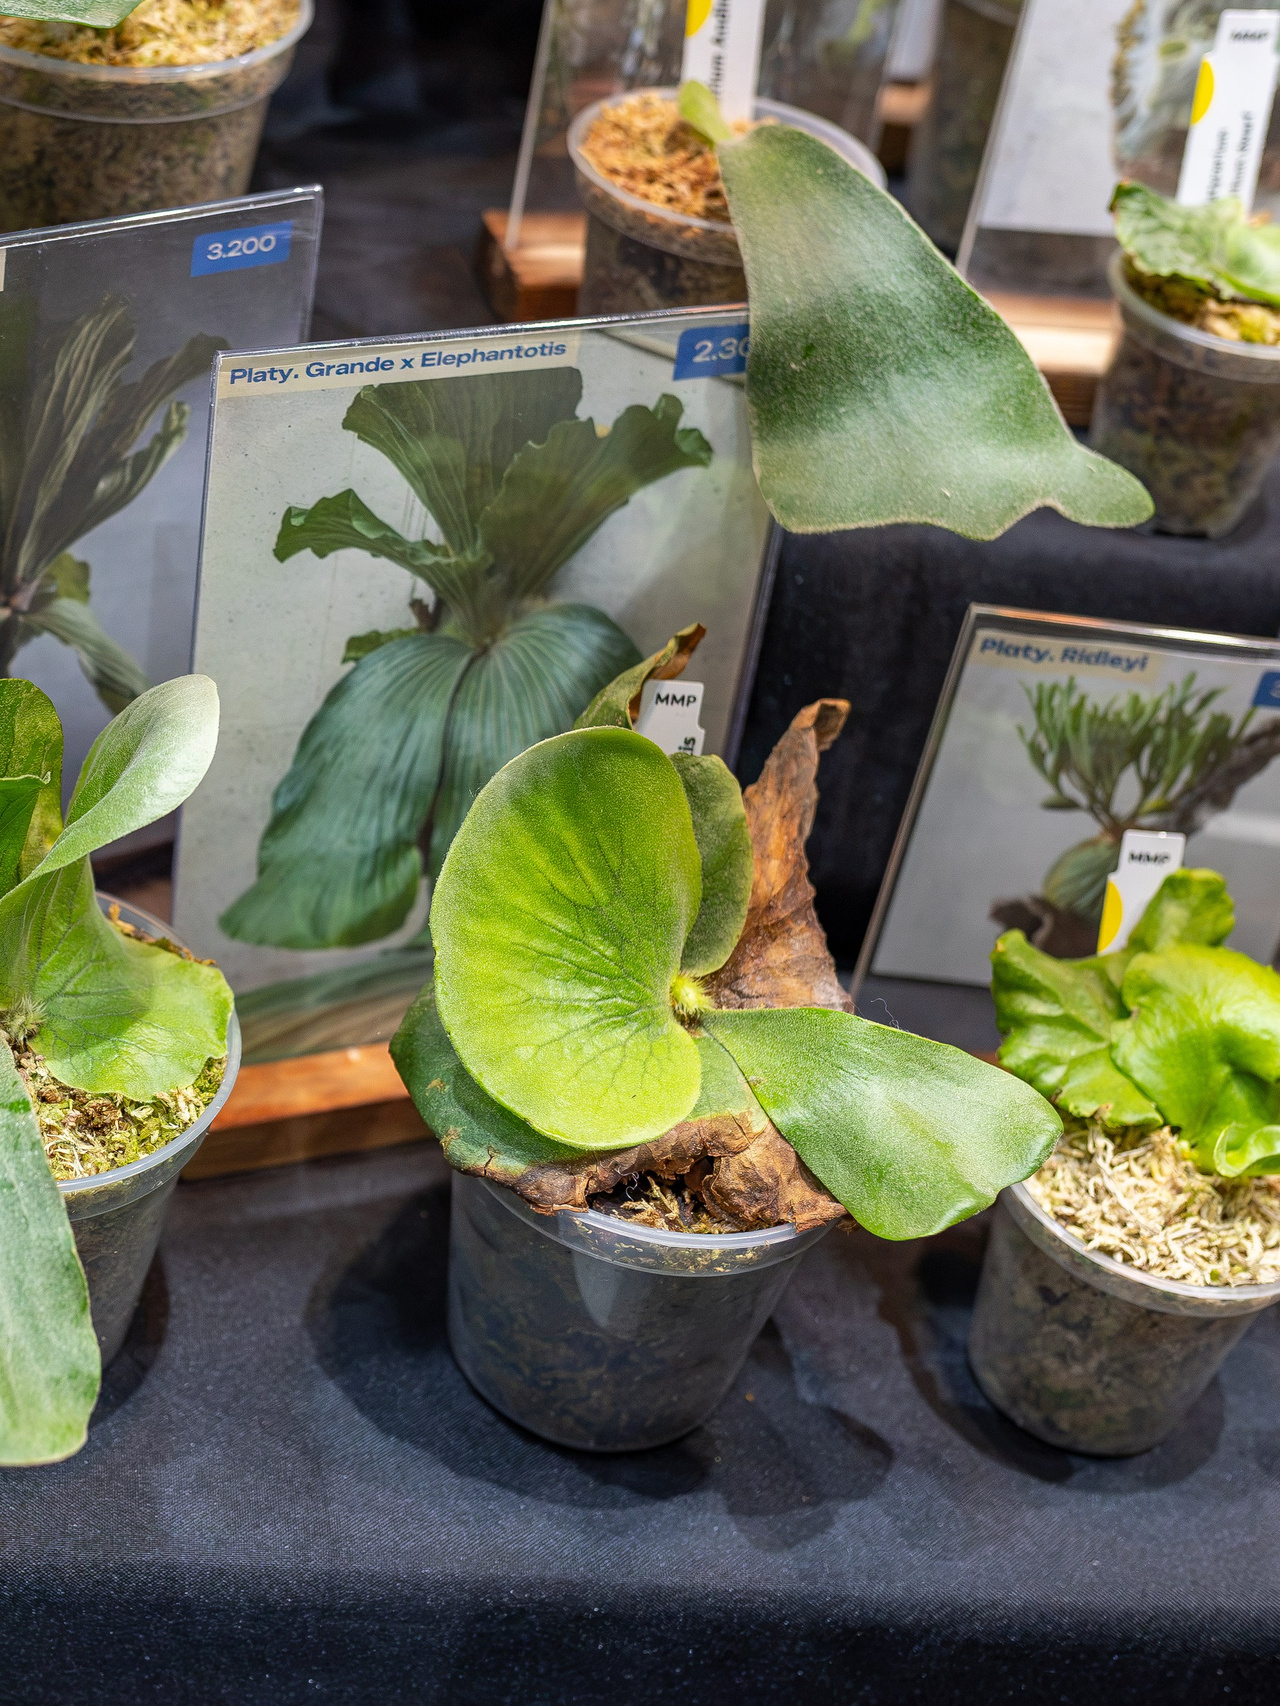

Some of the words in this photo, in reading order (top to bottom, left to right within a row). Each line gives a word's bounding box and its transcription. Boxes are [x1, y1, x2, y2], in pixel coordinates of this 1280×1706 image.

[206, 234, 277, 260] 3.200
[230, 366, 300, 385] Platy.
[305, 356, 395, 379] Grande
[400, 357, 416, 370] x
[420, 340, 567, 369] Elephantotis
[979, 636, 1055, 664] Platy.
[655, 692, 697, 707] MMP
